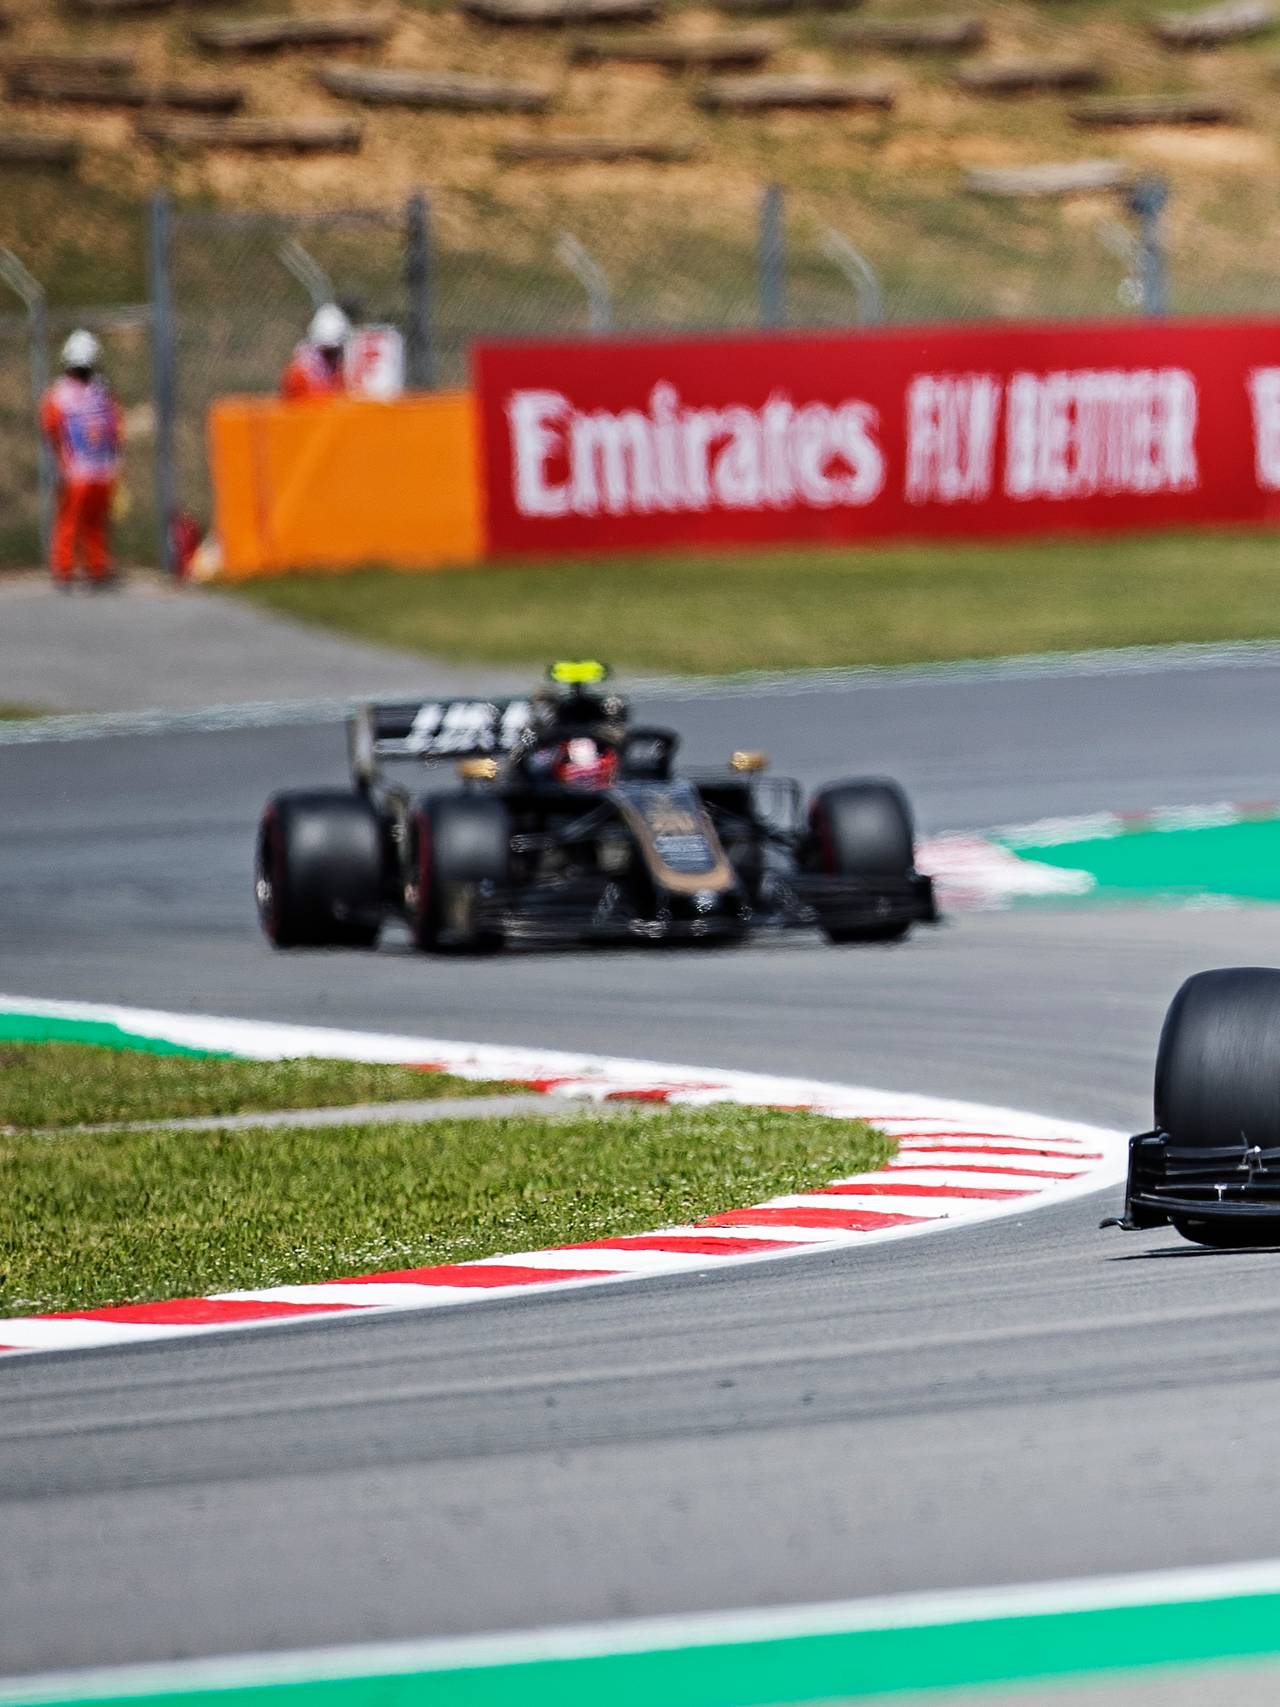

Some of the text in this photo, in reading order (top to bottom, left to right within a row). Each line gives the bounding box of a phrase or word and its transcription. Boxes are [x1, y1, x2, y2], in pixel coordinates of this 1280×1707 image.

[506, 367, 1198, 517] Emirates FLY BETTER
